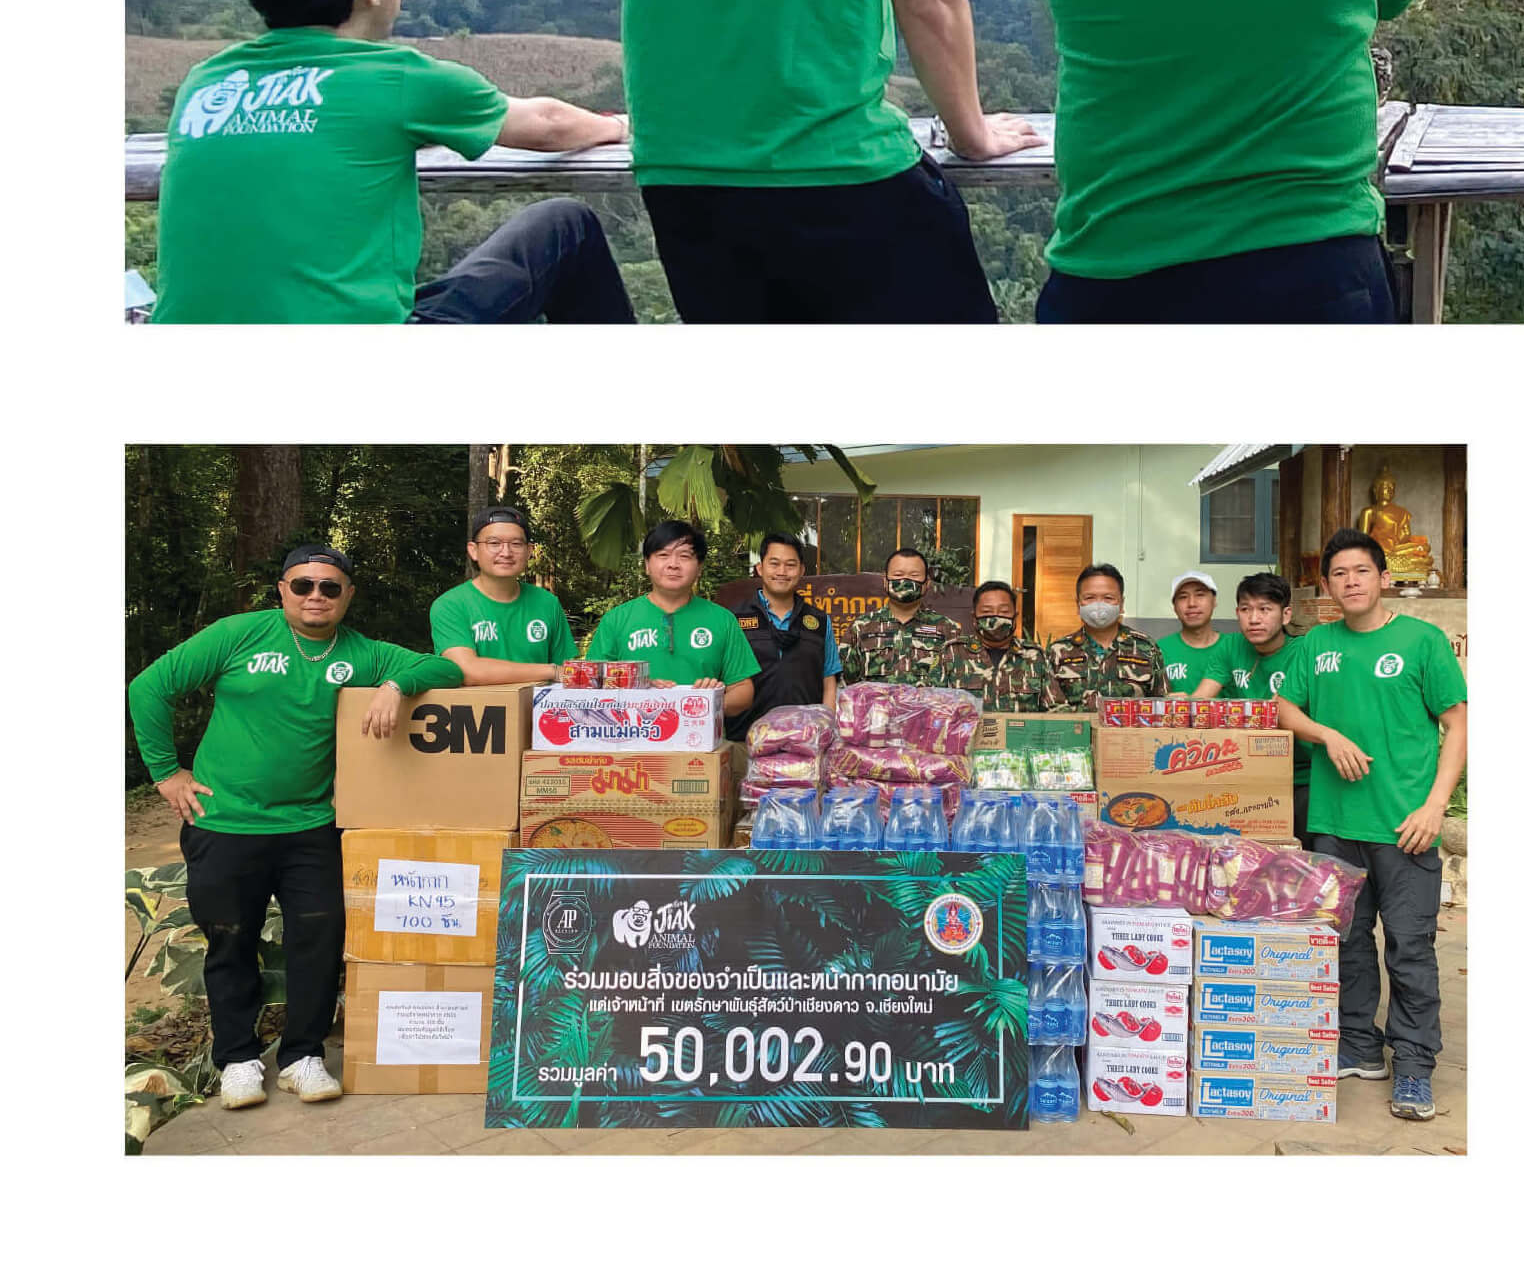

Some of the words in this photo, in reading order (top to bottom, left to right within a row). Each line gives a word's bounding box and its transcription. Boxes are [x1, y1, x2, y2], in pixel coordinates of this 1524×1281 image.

[231, 108, 319, 125] ANIMAL
[409, 704, 506, 755] 3M
[569, 721, 661, 739] สามแม่ครัว
[396, 915, 432, 928] 700
[648, 941, 695, 950] FOUNDATION
[651, 932, 696, 943] ANIMAL
[1203, 939, 1253, 962] Lactasoy
[1261, 946, 1314, 963] Original
[563, 962, 959, 993] ร่วมมอบสิ่งของจำเป็นและหน้ากากอนามัย
[671, 996, 860, 1018] เขตรักษาพันธุ์สัตว์ป่าเชียงดาว
[866, 995, 933, 1014] จ.เชียงใหม่
[1203, 988, 1253, 1009] Lactasoy
[1261, 994, 1314, 1011] Original
[1204, 1035, 1253, 1057] Lactasoy
[1261, 1041, 1314, 1058] Original
[538, 1062, 617, 1088] รวมมูลค่า
[639, 1025, 892, 1087] 50,002.90
[905, 1061, 955, 1083] บาท
[1202, 1082, 1252, 1104] Lactasoy
[1259, 1087, 1312, 1105] Original
